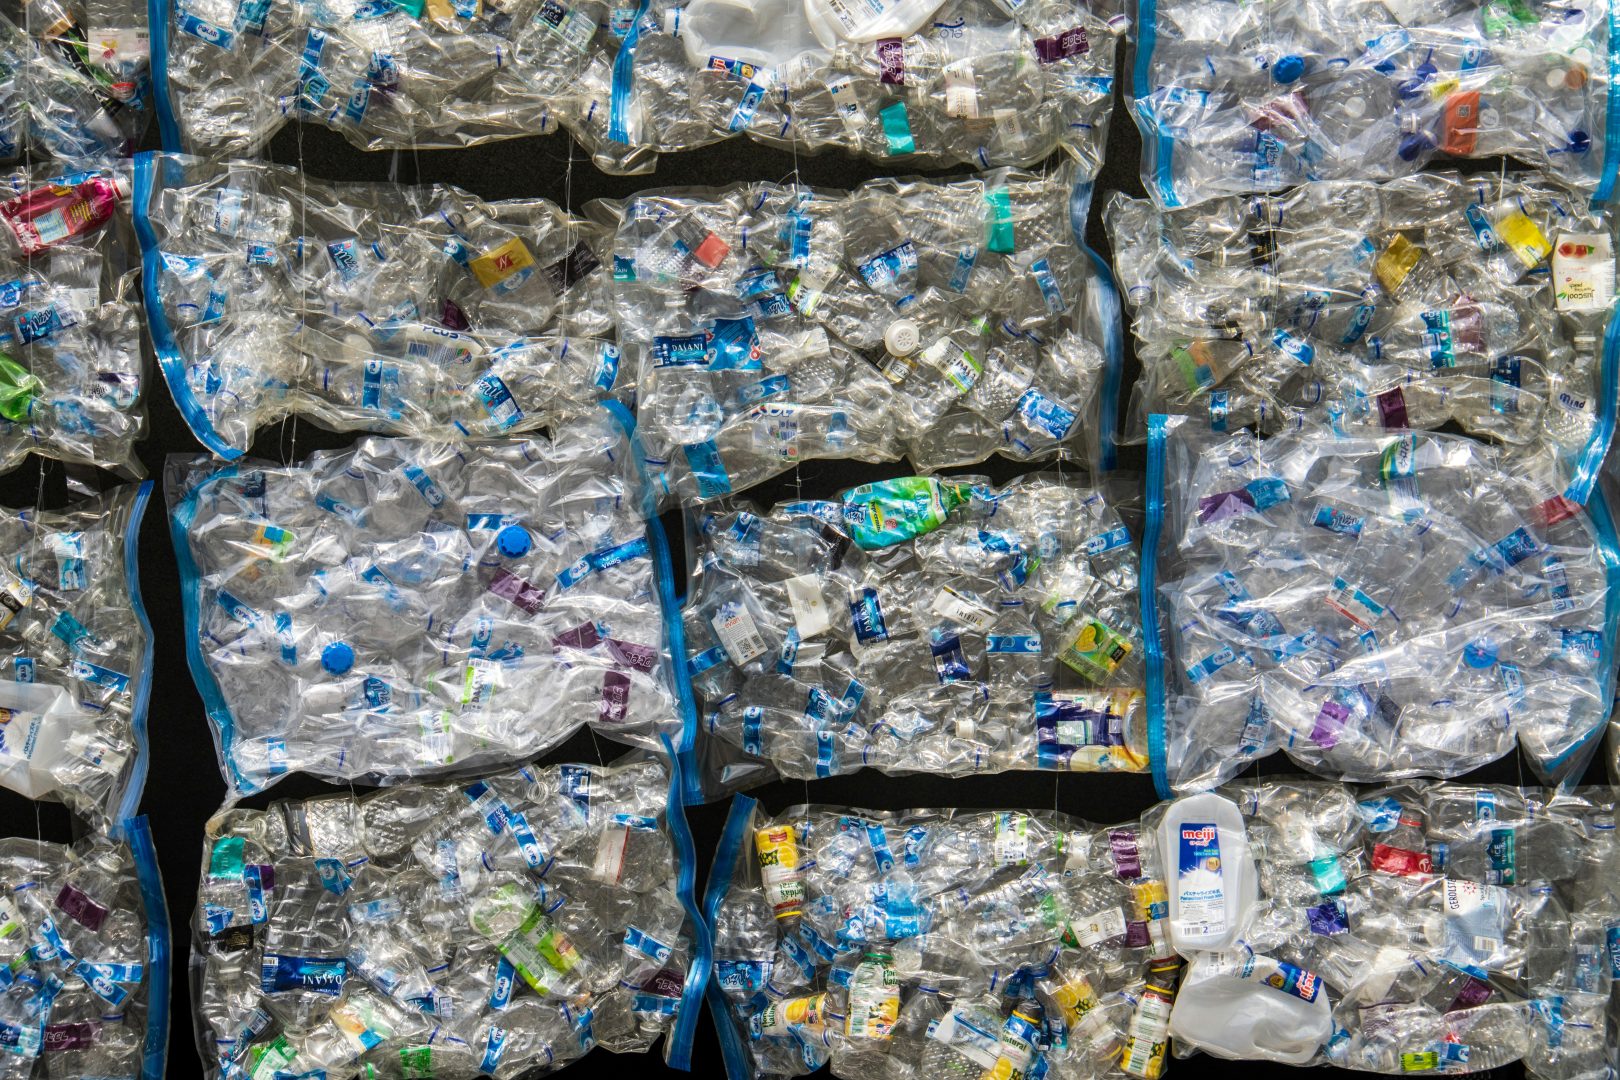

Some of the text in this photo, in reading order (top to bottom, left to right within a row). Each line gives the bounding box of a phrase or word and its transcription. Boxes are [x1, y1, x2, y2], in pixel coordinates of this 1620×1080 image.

[197, 23, 218, 39] POLAR
[671, 342, 703, 354] DASANI
[1182, 828, 1215, 841] meiji
[95, 978, 114, 994] POLAR
[302, 975, 342, 986] DASANI
